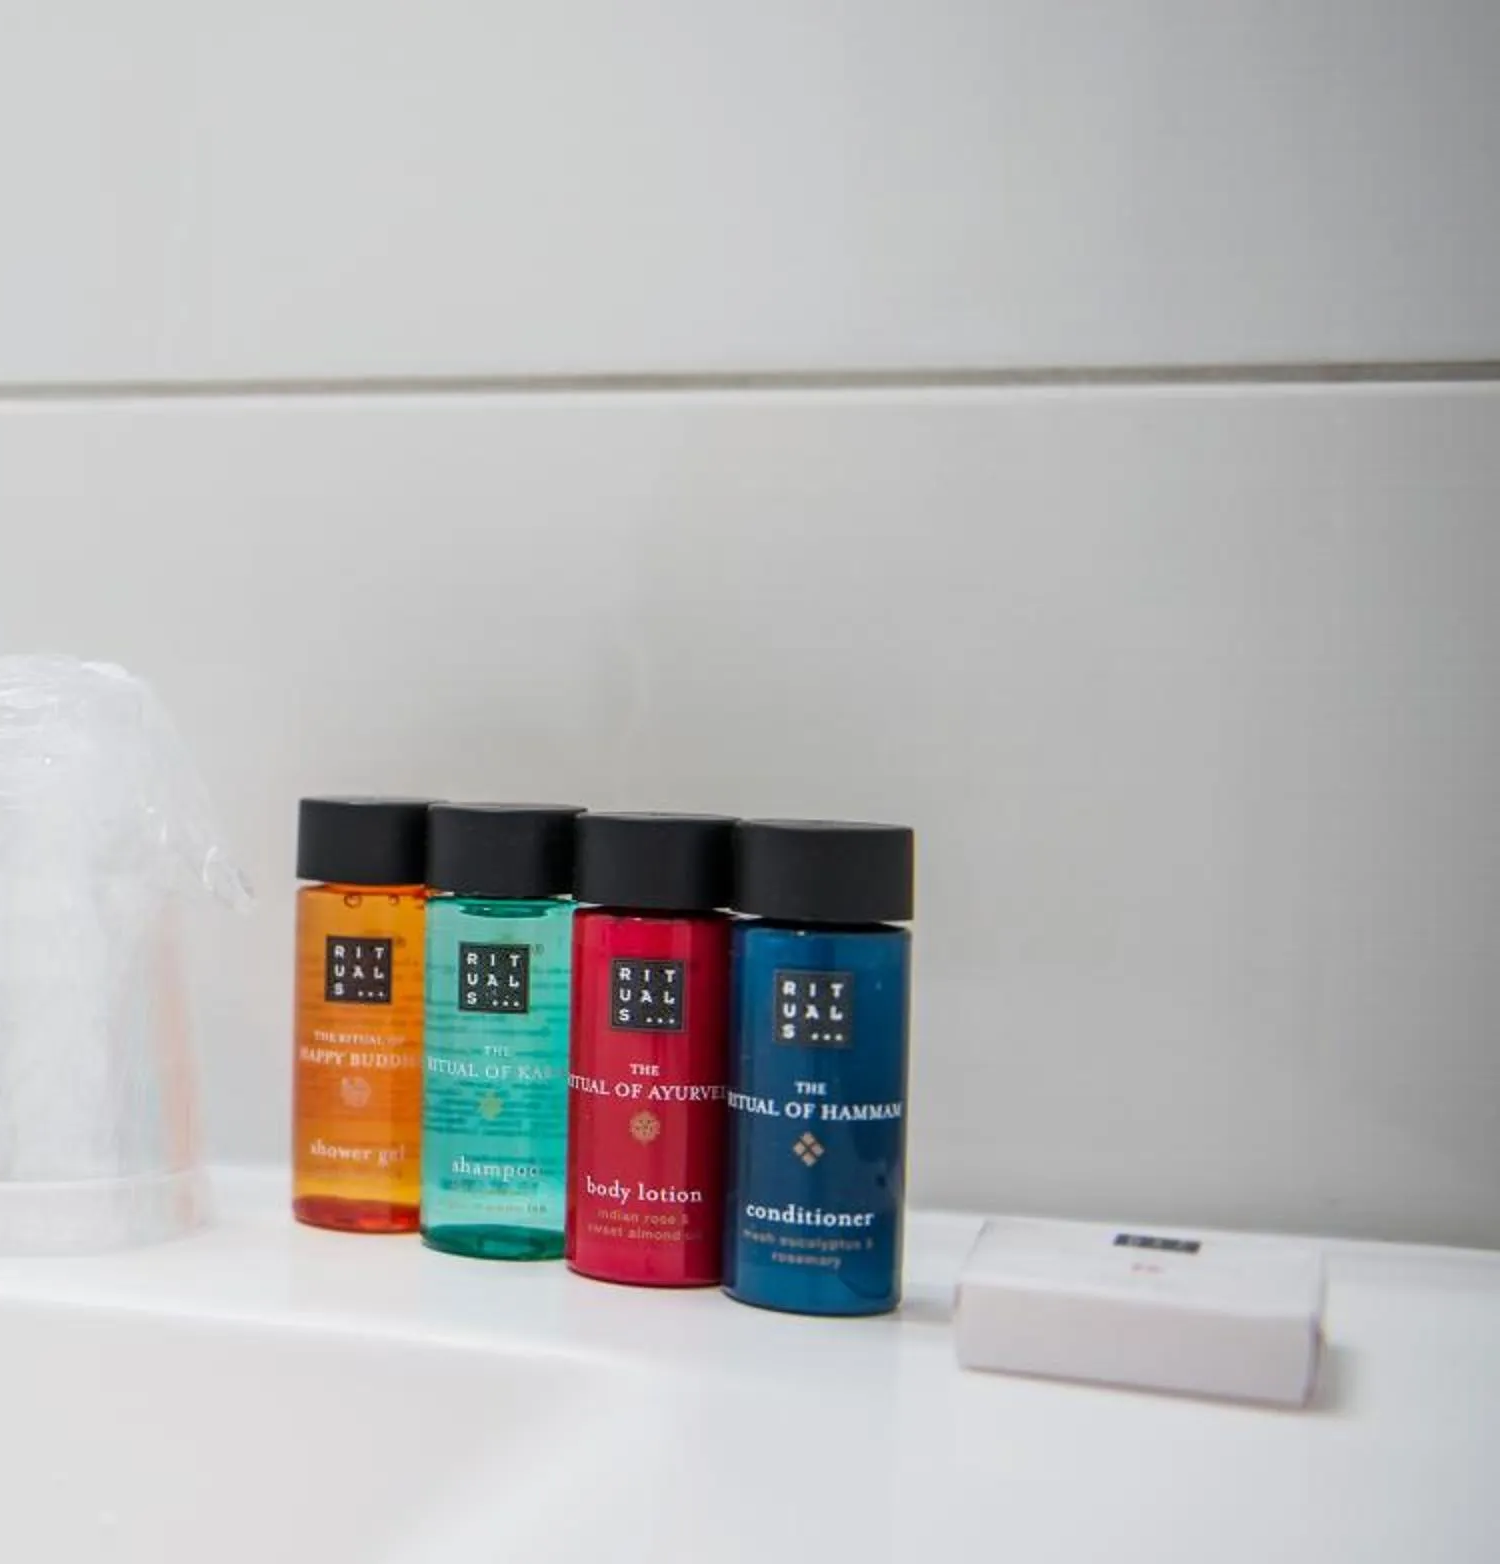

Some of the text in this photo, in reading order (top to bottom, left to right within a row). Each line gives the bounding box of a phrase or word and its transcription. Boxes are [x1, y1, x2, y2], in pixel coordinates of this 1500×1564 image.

[466, 953, 520, 968] RIT
[466, 973, 520, 988] UAL
[618, 967, 677, 983] RIT
[618, 988, 676, 1004] UAL
[782, 980, 844, 998] RIT
[782, 1003, 844, 1021] UAL
[484, 1045, 510, 1057] THE
[485, 1065, 511, 1080] OF
[629, 1063, 661, 1077] THE
[614, 1082, 643, 1099] OF
[794, 1081, 828, 1096] THE
[784, 1101, 816, 1120] OF
[310, 1138, 372, 1162] shower
[451, 1154, 540, 1182] shampoo
[586, 1175, 703, 1205] body lotion
[643, 1213, 677, 1226] rose
[745, 1203, 875, 1227] conditioner
[627, 1226, 681, 1242] almond
